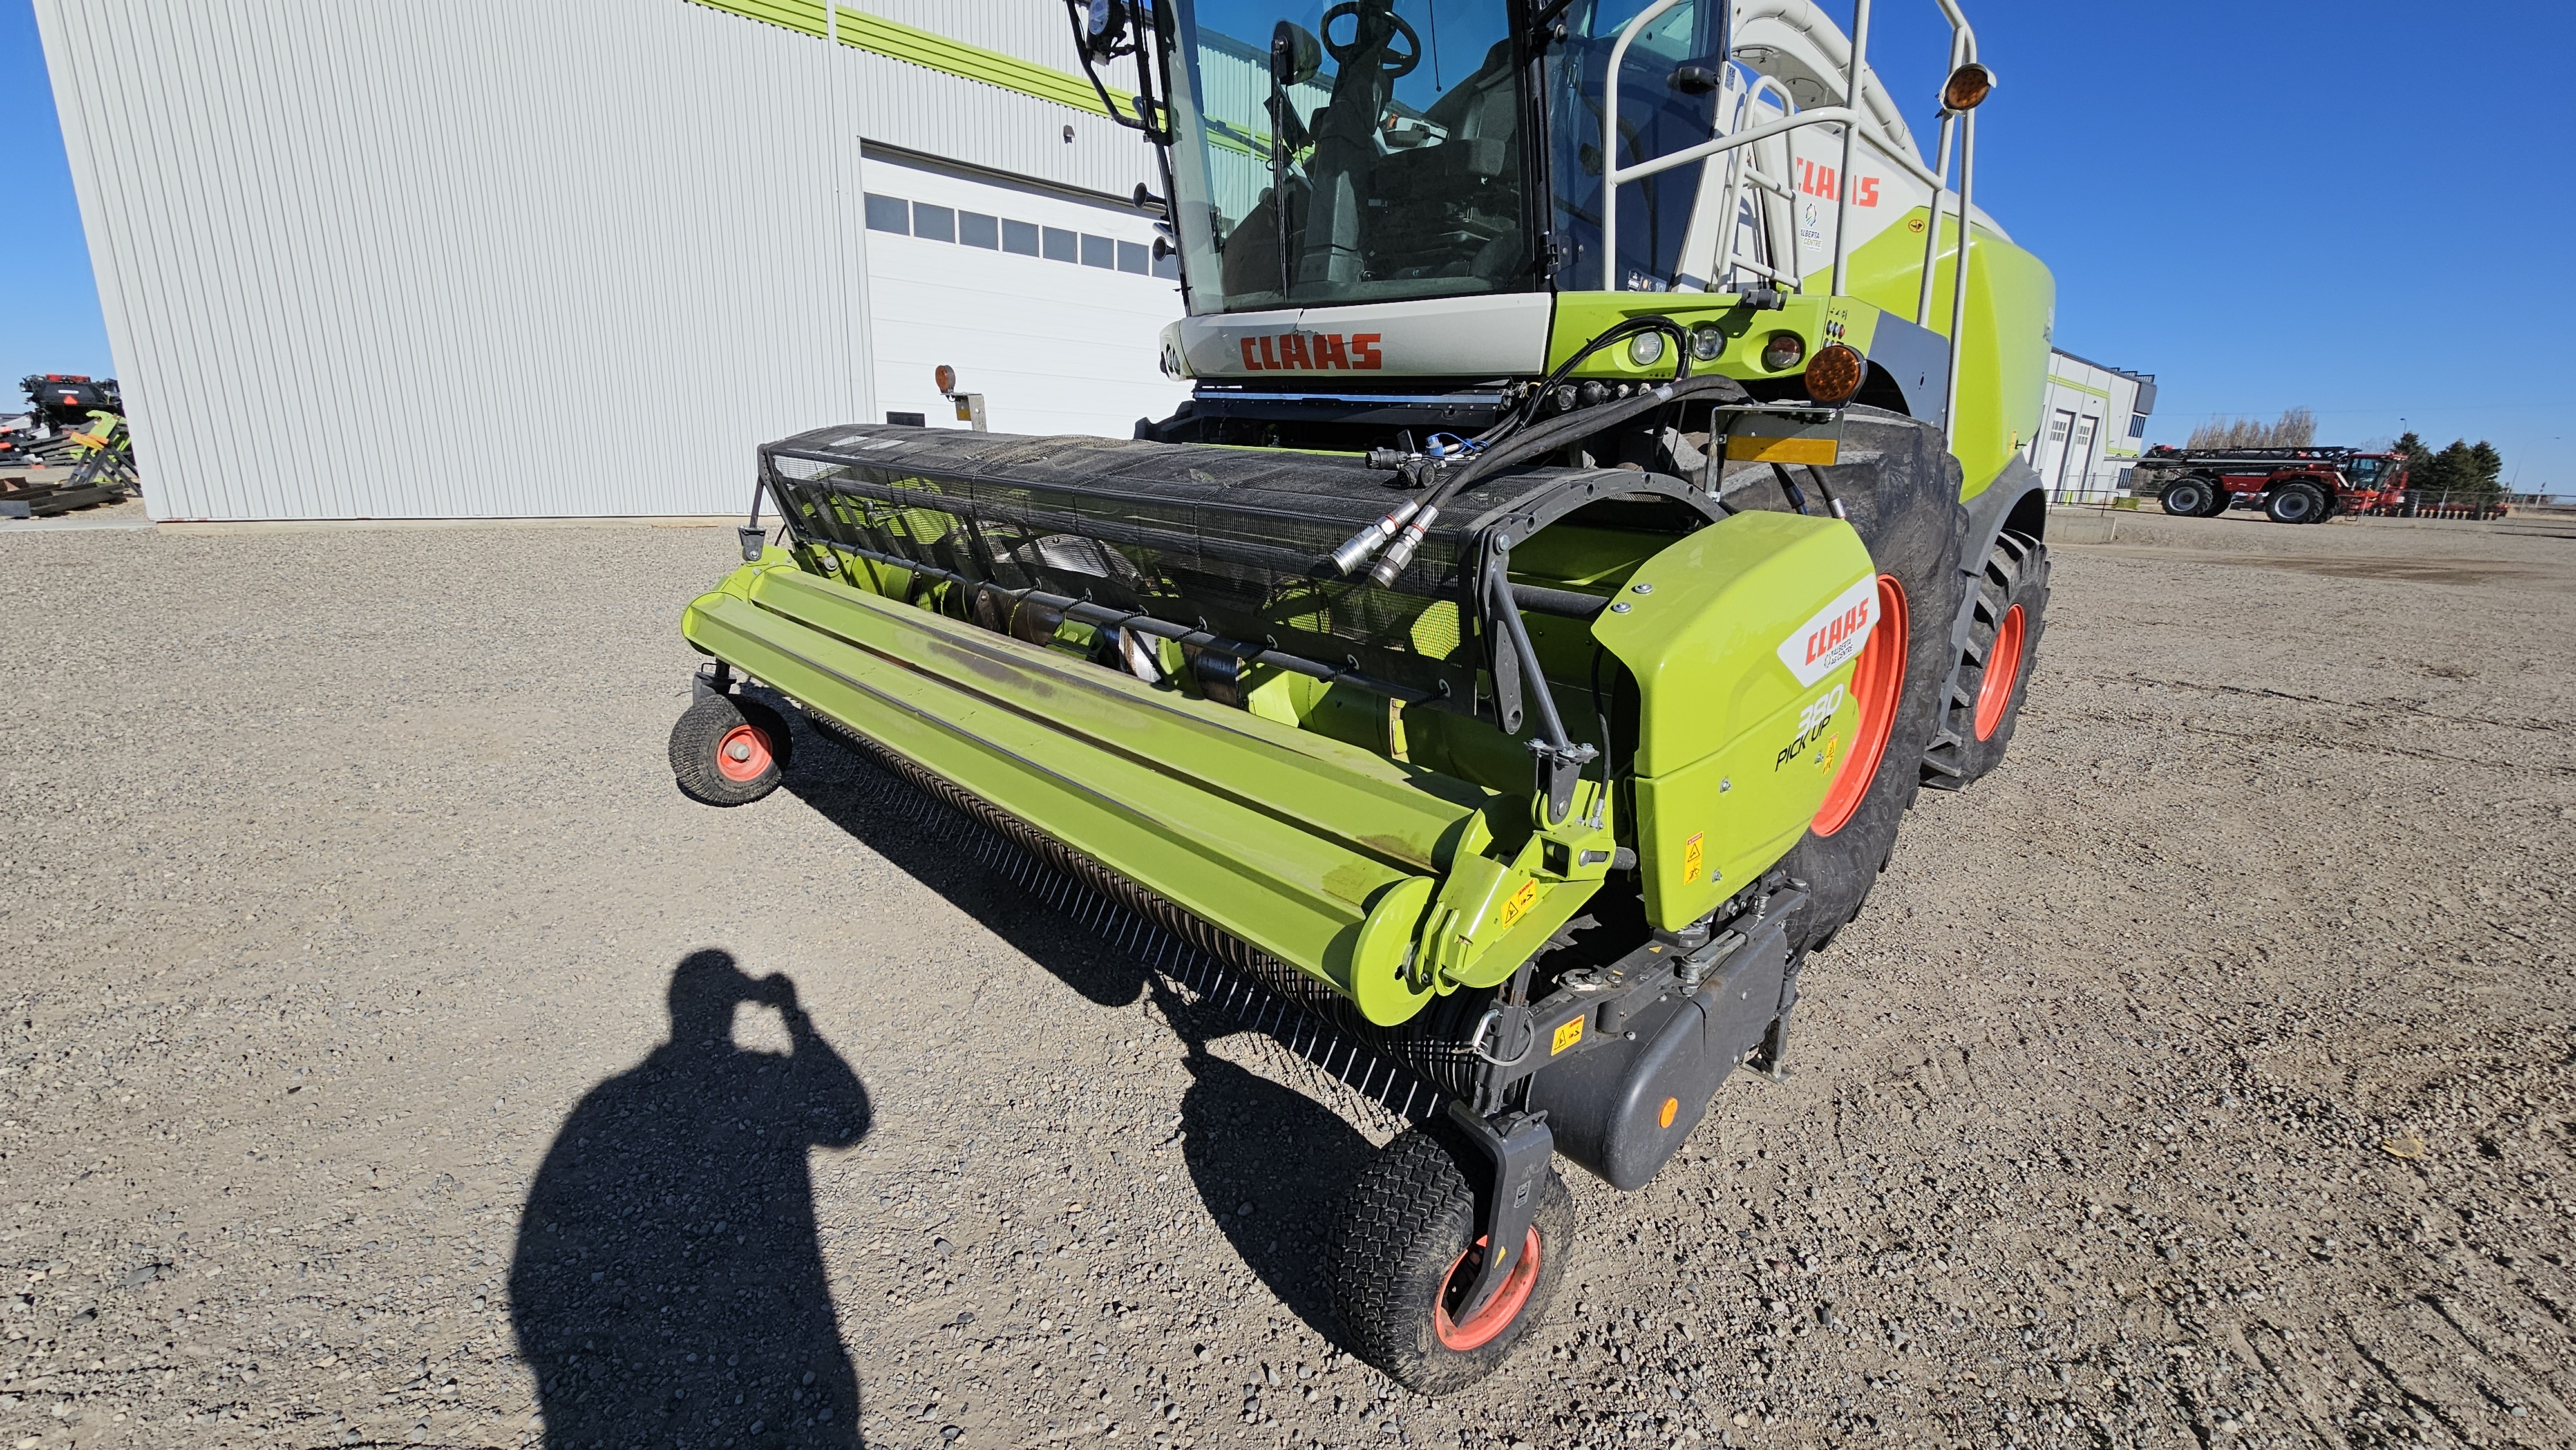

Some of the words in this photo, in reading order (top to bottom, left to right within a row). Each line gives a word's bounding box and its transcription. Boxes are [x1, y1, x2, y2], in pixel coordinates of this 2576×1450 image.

[1240, 333, 1382, 370] CLAAS
[1805, 597, 1869, 666] CLAAS
[1795, 683, 1844, 740] 380
[1775, 729, 1810, 773] PICK
[1811, 714, 1831, 742] UP
